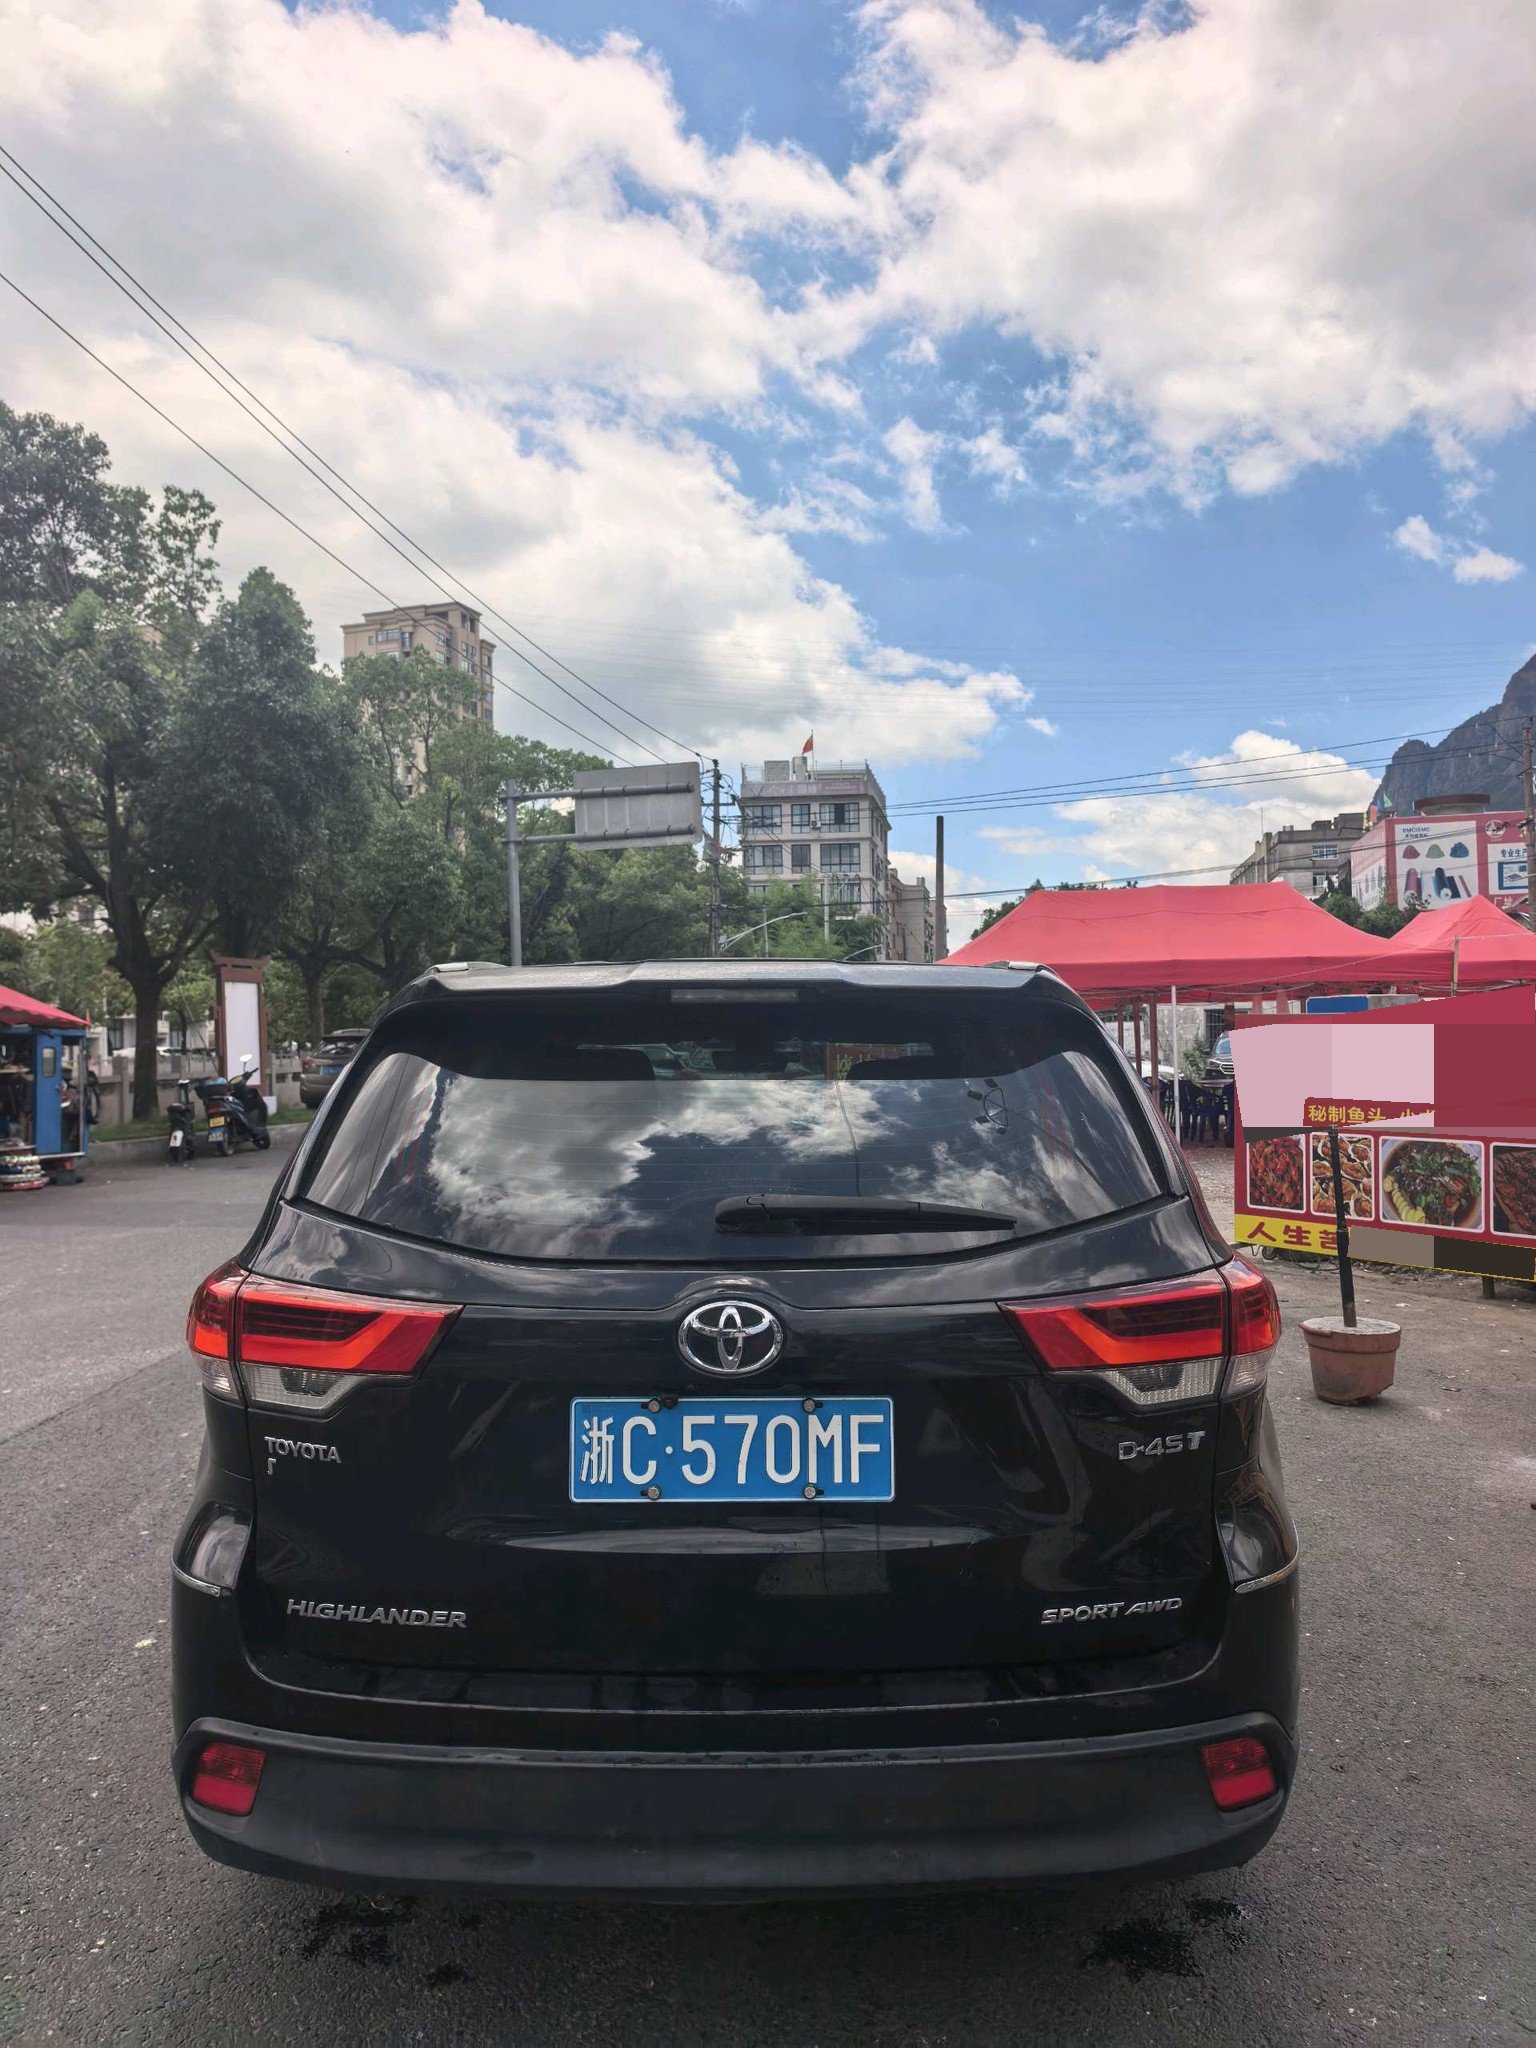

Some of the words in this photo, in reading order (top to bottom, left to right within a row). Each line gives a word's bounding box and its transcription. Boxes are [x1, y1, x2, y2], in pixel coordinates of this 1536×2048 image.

[1308, 1105, 1386, 1123] 秘制鱼头
[264, 1436, 342, 1464] TOYOTA
[287, 1599, 467, 1628] HIGHLANDER
[1041, 1602, 1125, 1625] SPORT
[1124, 1597, 1183, 1616] AWD
